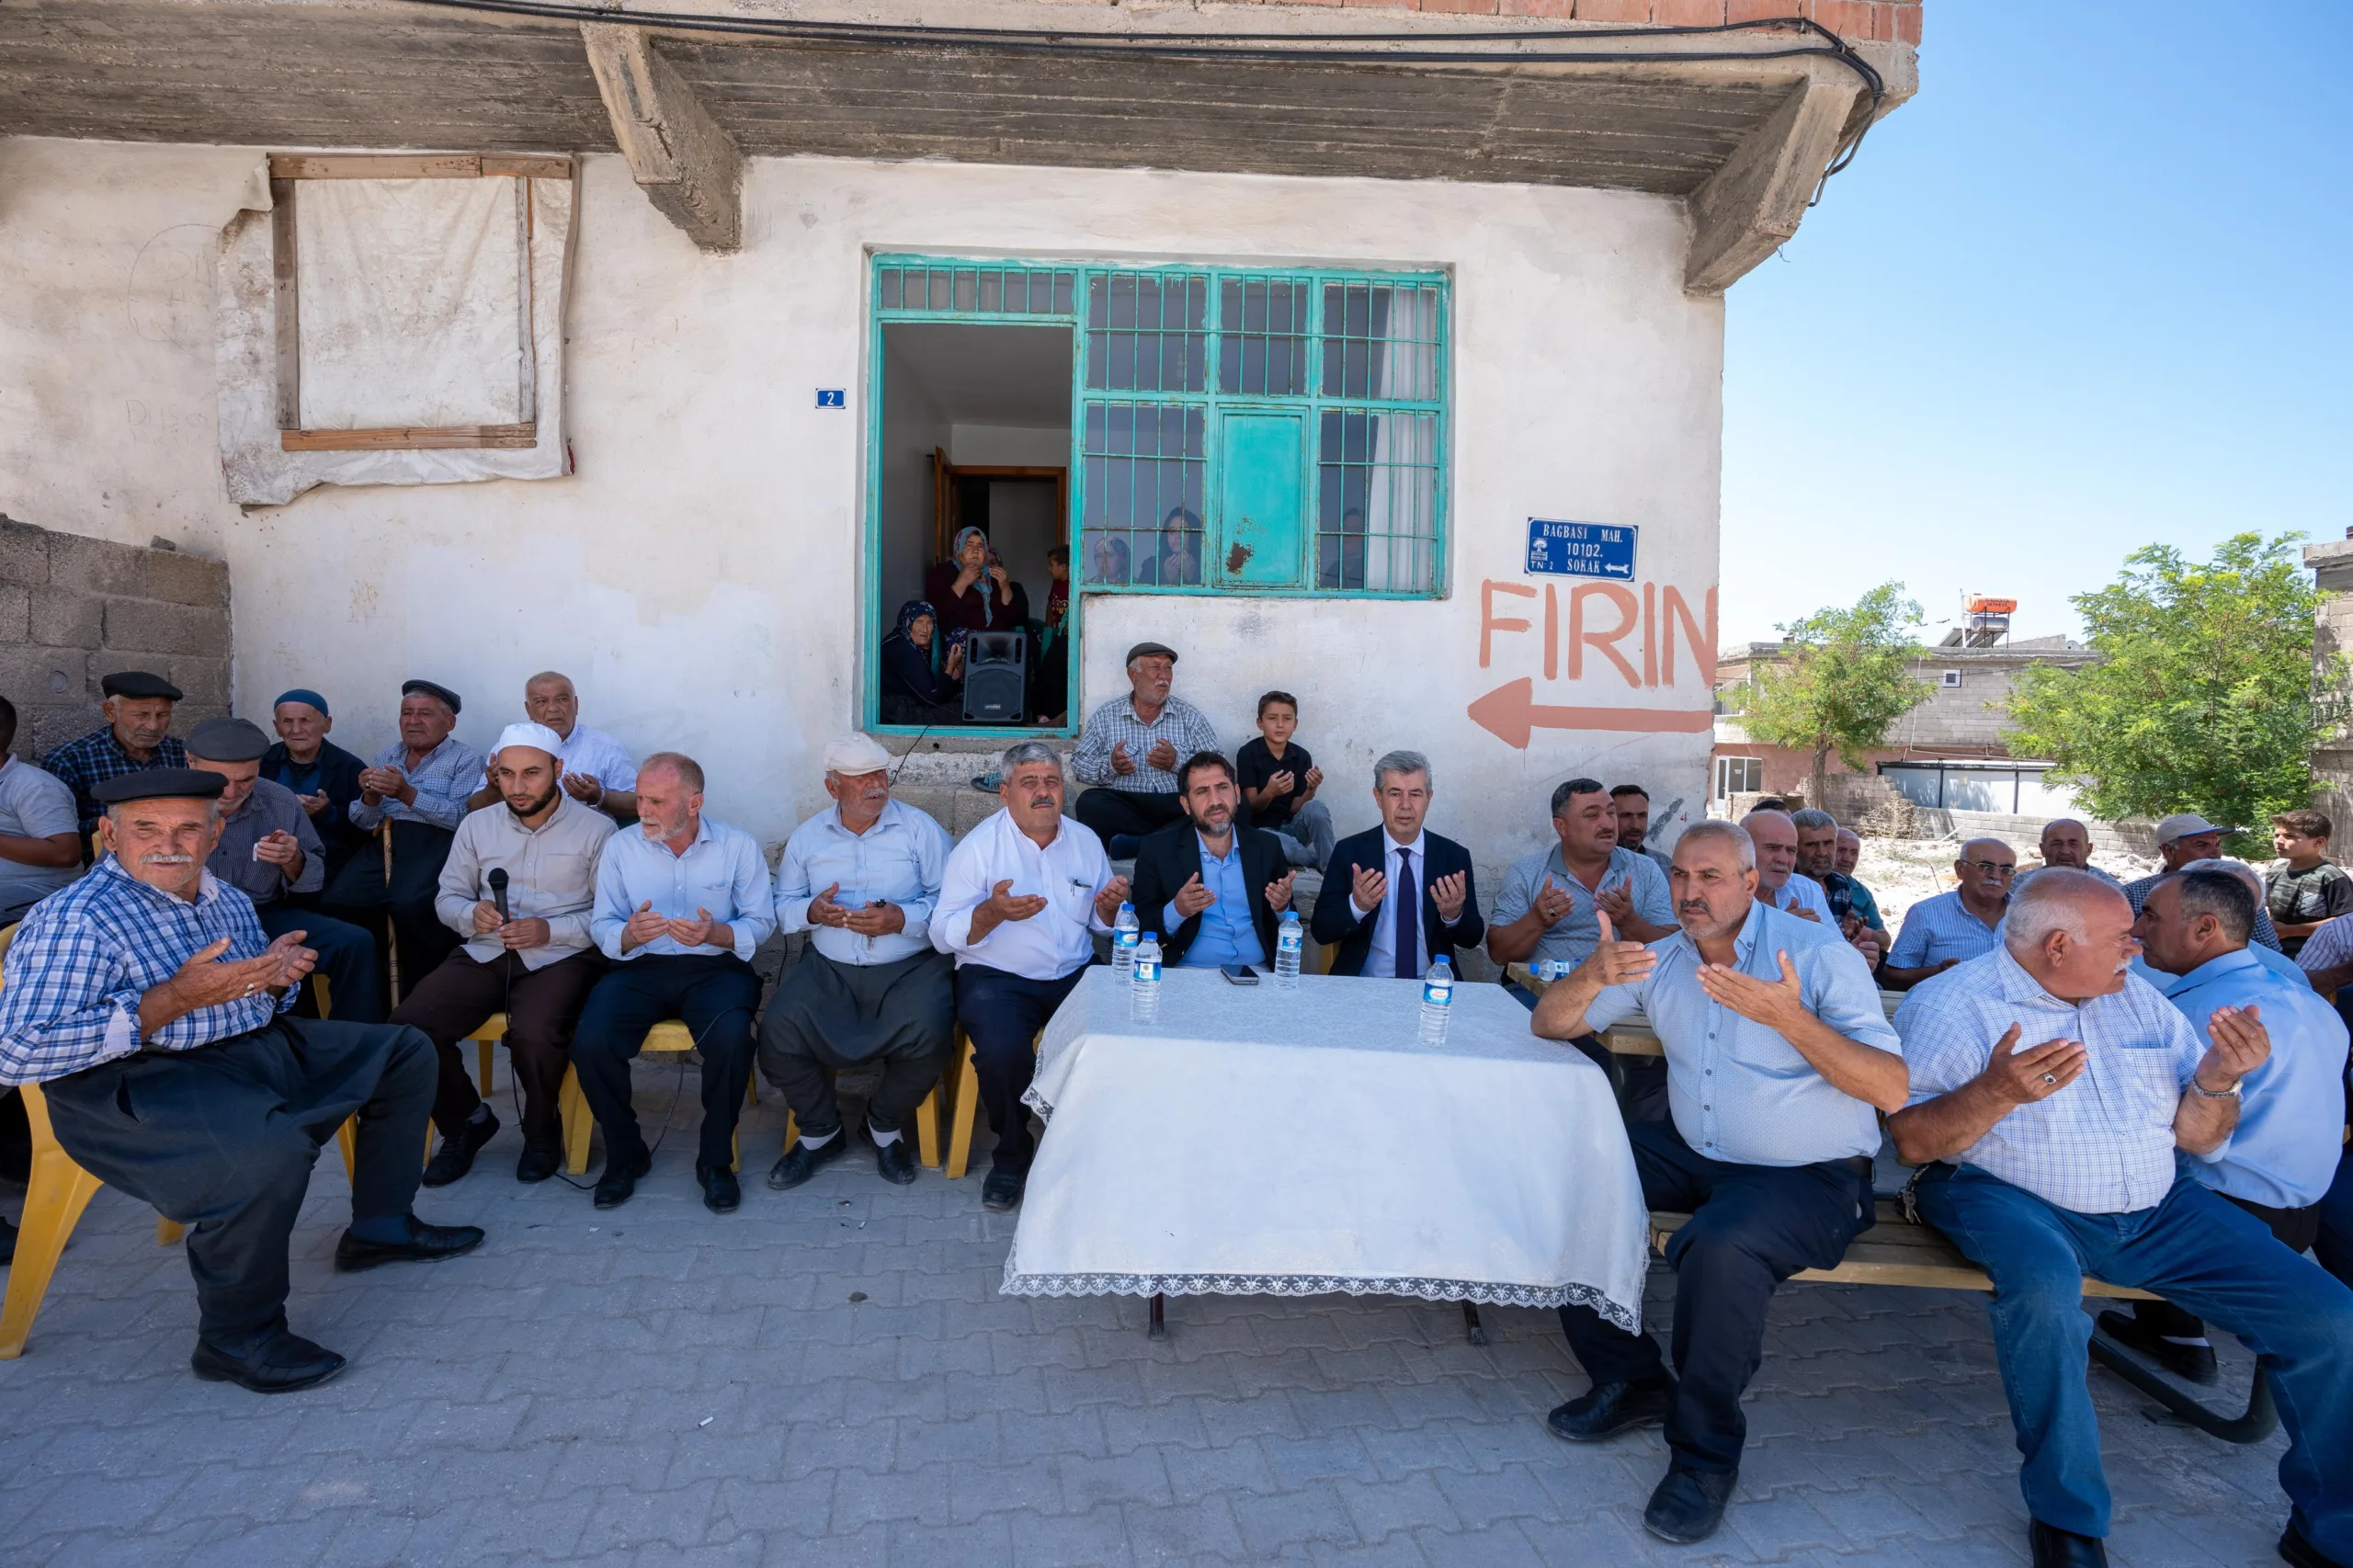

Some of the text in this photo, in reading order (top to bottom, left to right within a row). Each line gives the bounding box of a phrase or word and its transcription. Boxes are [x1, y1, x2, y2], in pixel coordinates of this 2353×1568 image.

[827, 392, 834, 405] 2
[1600, 528, 1623, 543] MAH.
[1566, 542, 1604, 558] 10102.
[1549, 561, 1554, 570] 2
[1566, 558, 1600, 573] SOKAK
[1479, 578, 1718, 690] FIRIN
